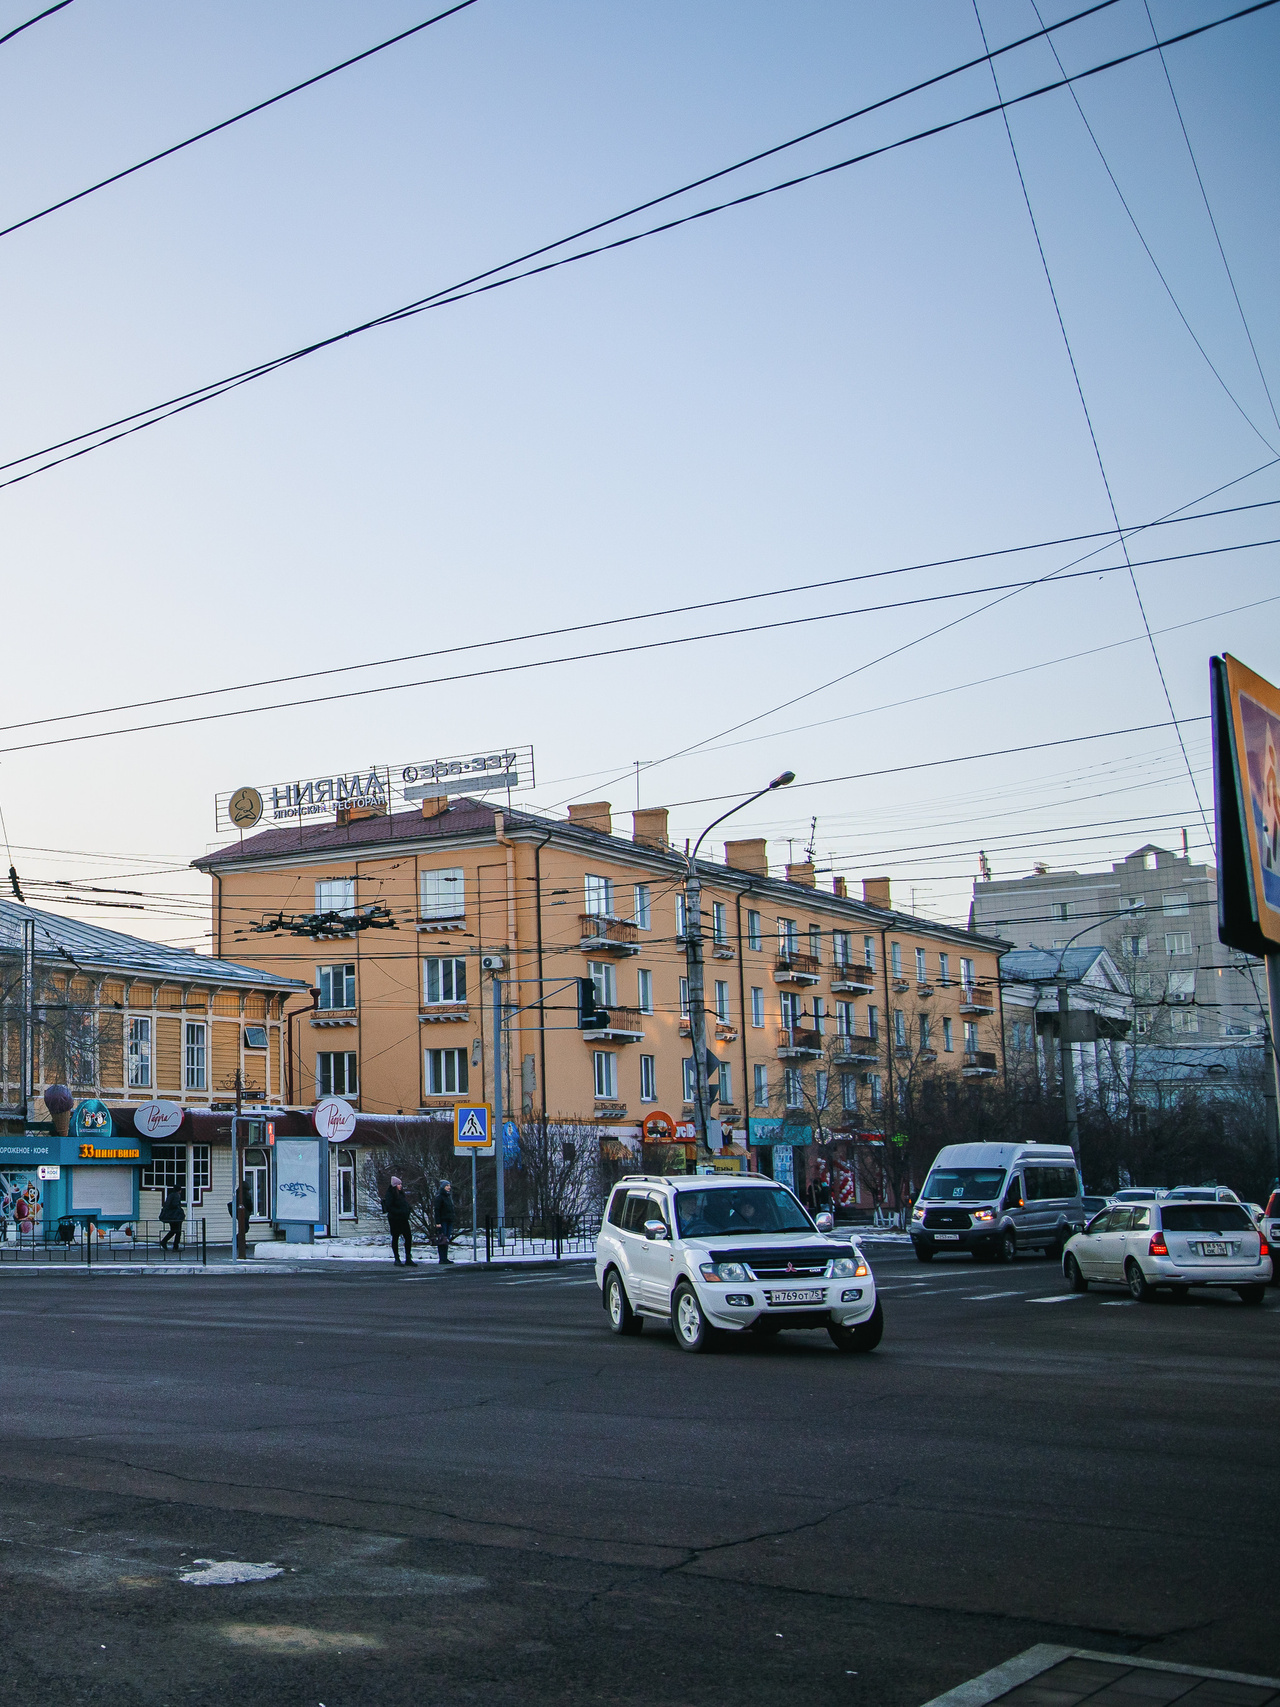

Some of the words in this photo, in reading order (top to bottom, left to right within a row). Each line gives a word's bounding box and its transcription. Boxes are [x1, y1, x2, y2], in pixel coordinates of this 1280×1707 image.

[269, 773, 387, 809] НИЯМА
[274, 803, 326, 819] ЯПОНСКИЙ
[332, 795, 386, 811] РЕСТОРАН
[33, 1147, 49, 1155] КОФЕ
[79, 1144, 94, 1158] 33
[775, 1291, 808, 1301] Н769ОТ
